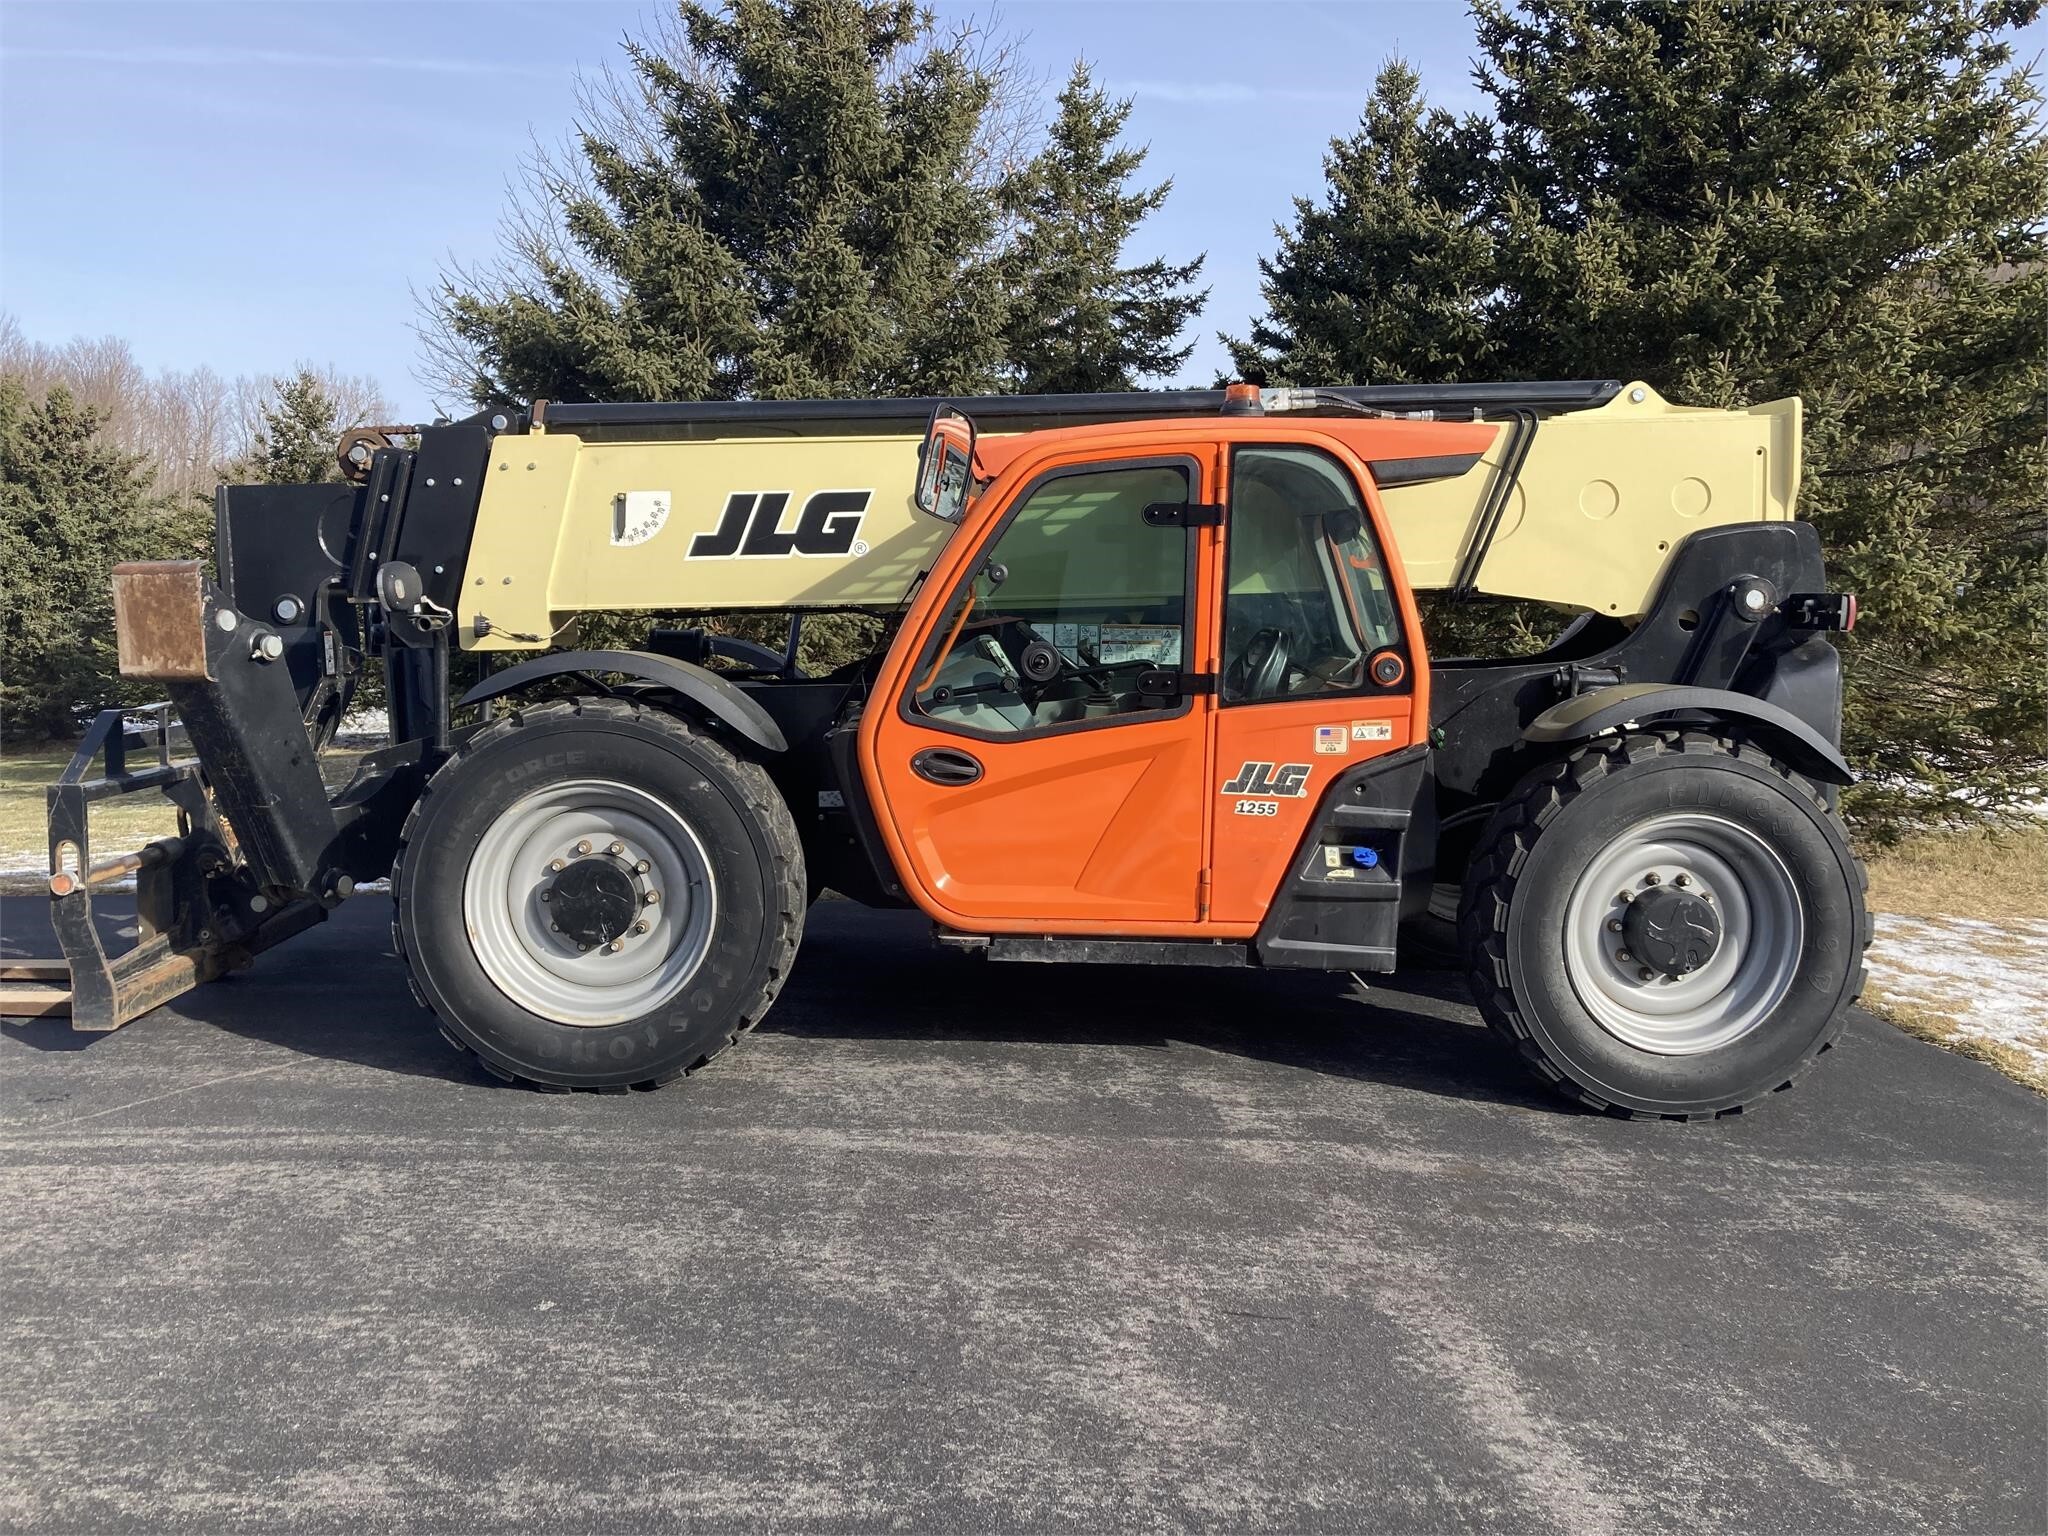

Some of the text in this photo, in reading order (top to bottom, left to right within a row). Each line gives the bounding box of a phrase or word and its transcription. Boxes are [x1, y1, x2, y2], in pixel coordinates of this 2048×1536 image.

[686, 489, 873, 558] JLG
[1223, 763, 1312, 797] JLG
[1236, 801, 1277, 815] 1255
